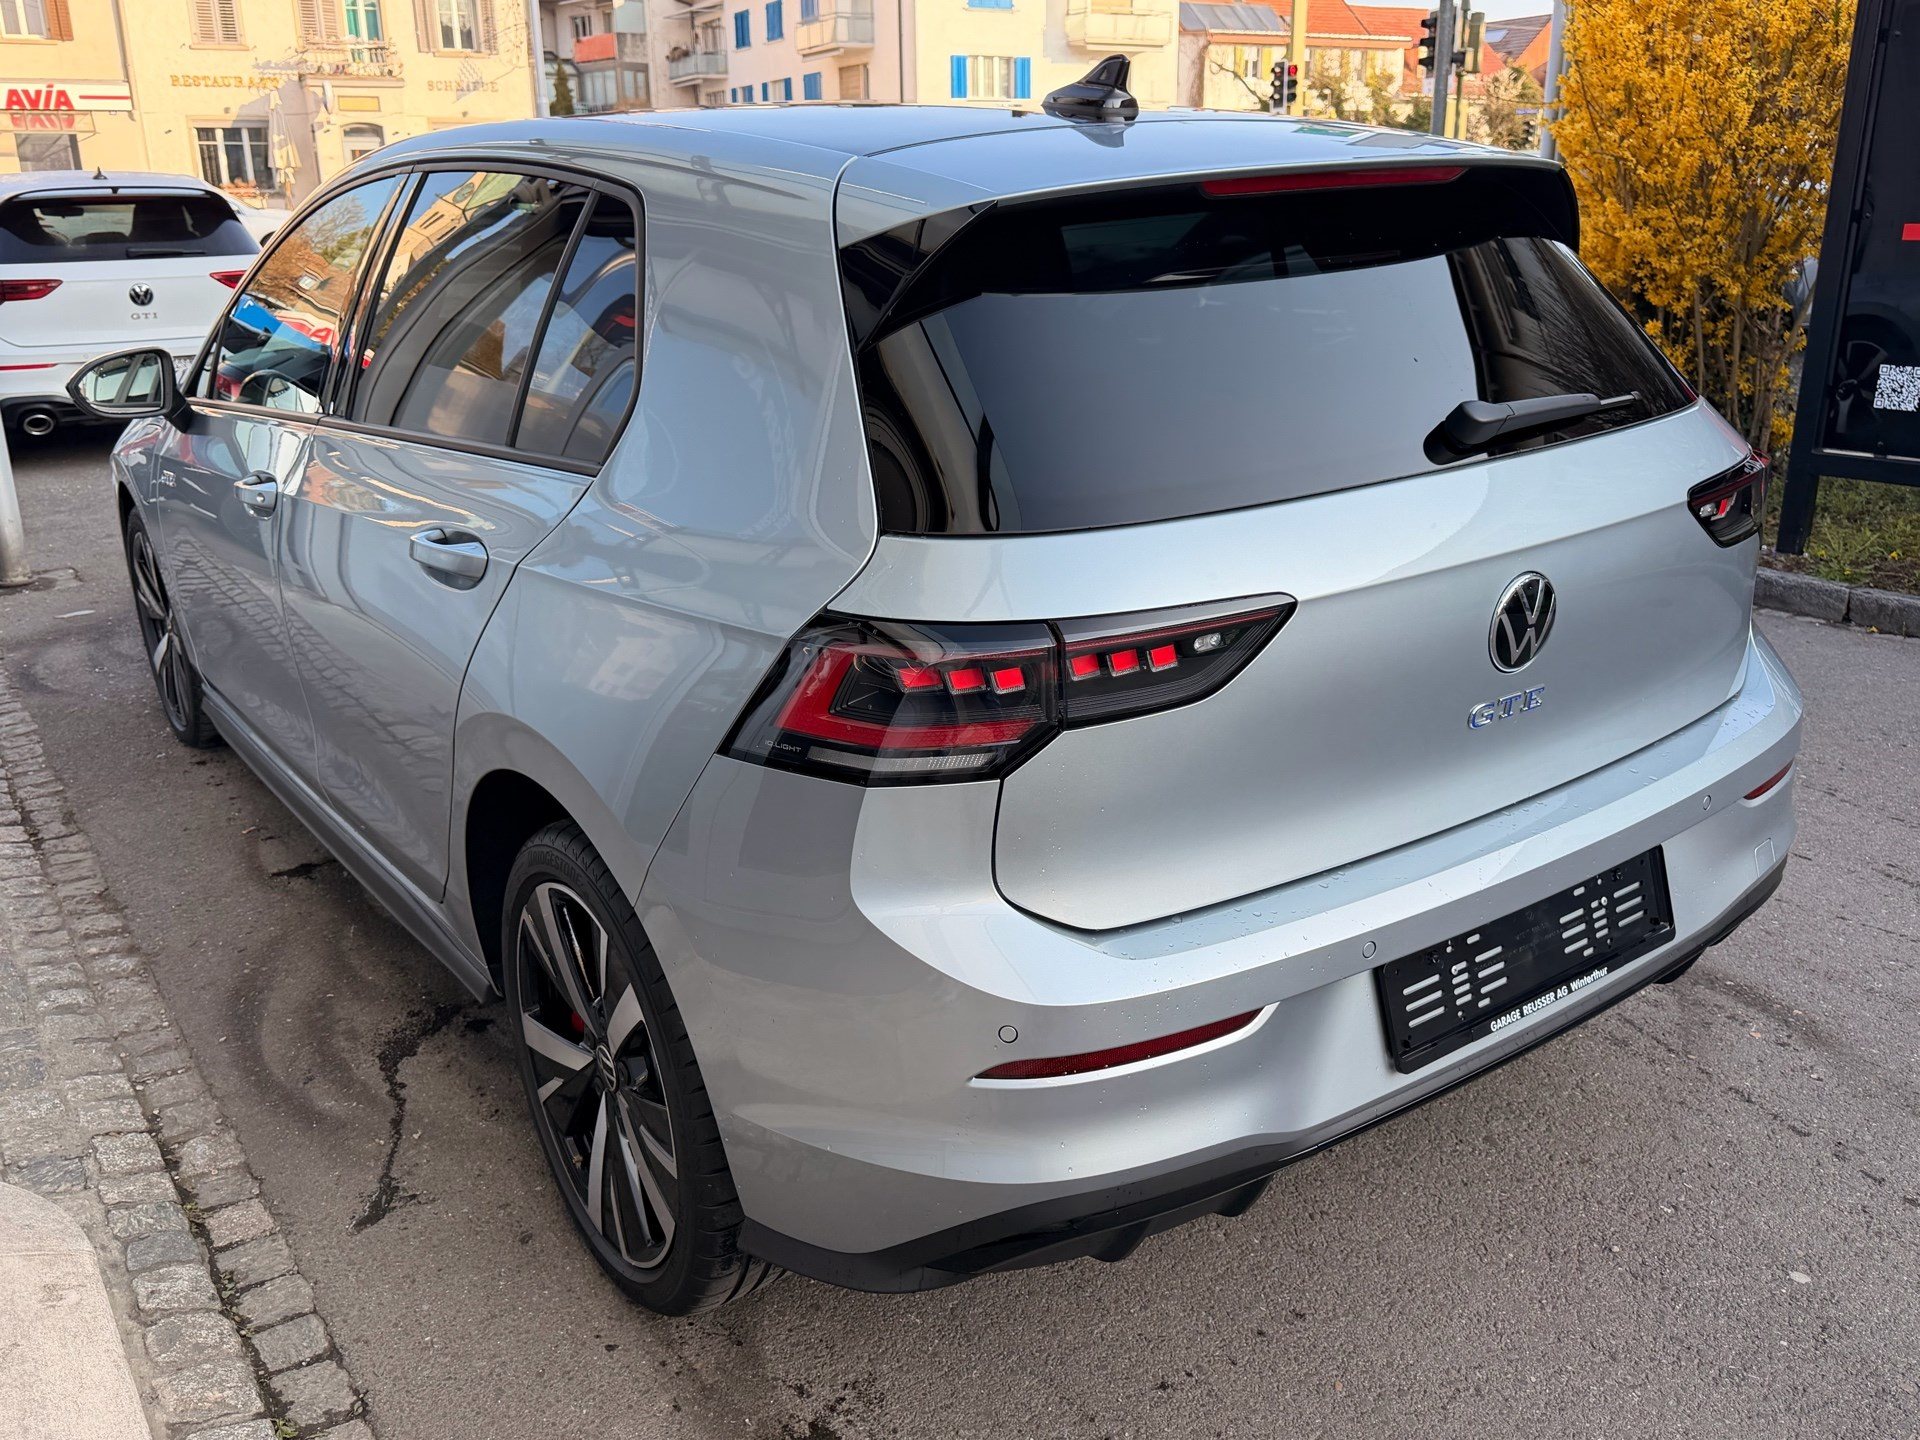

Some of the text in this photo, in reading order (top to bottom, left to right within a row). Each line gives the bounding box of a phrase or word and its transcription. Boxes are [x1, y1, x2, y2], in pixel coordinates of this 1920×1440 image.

[130, 312, 158, 320] GTI
[1467, 684, 1546, 730] GTE
[1490, 966, 1608, 1032] GARAGE REUSSER AG Winterthur
